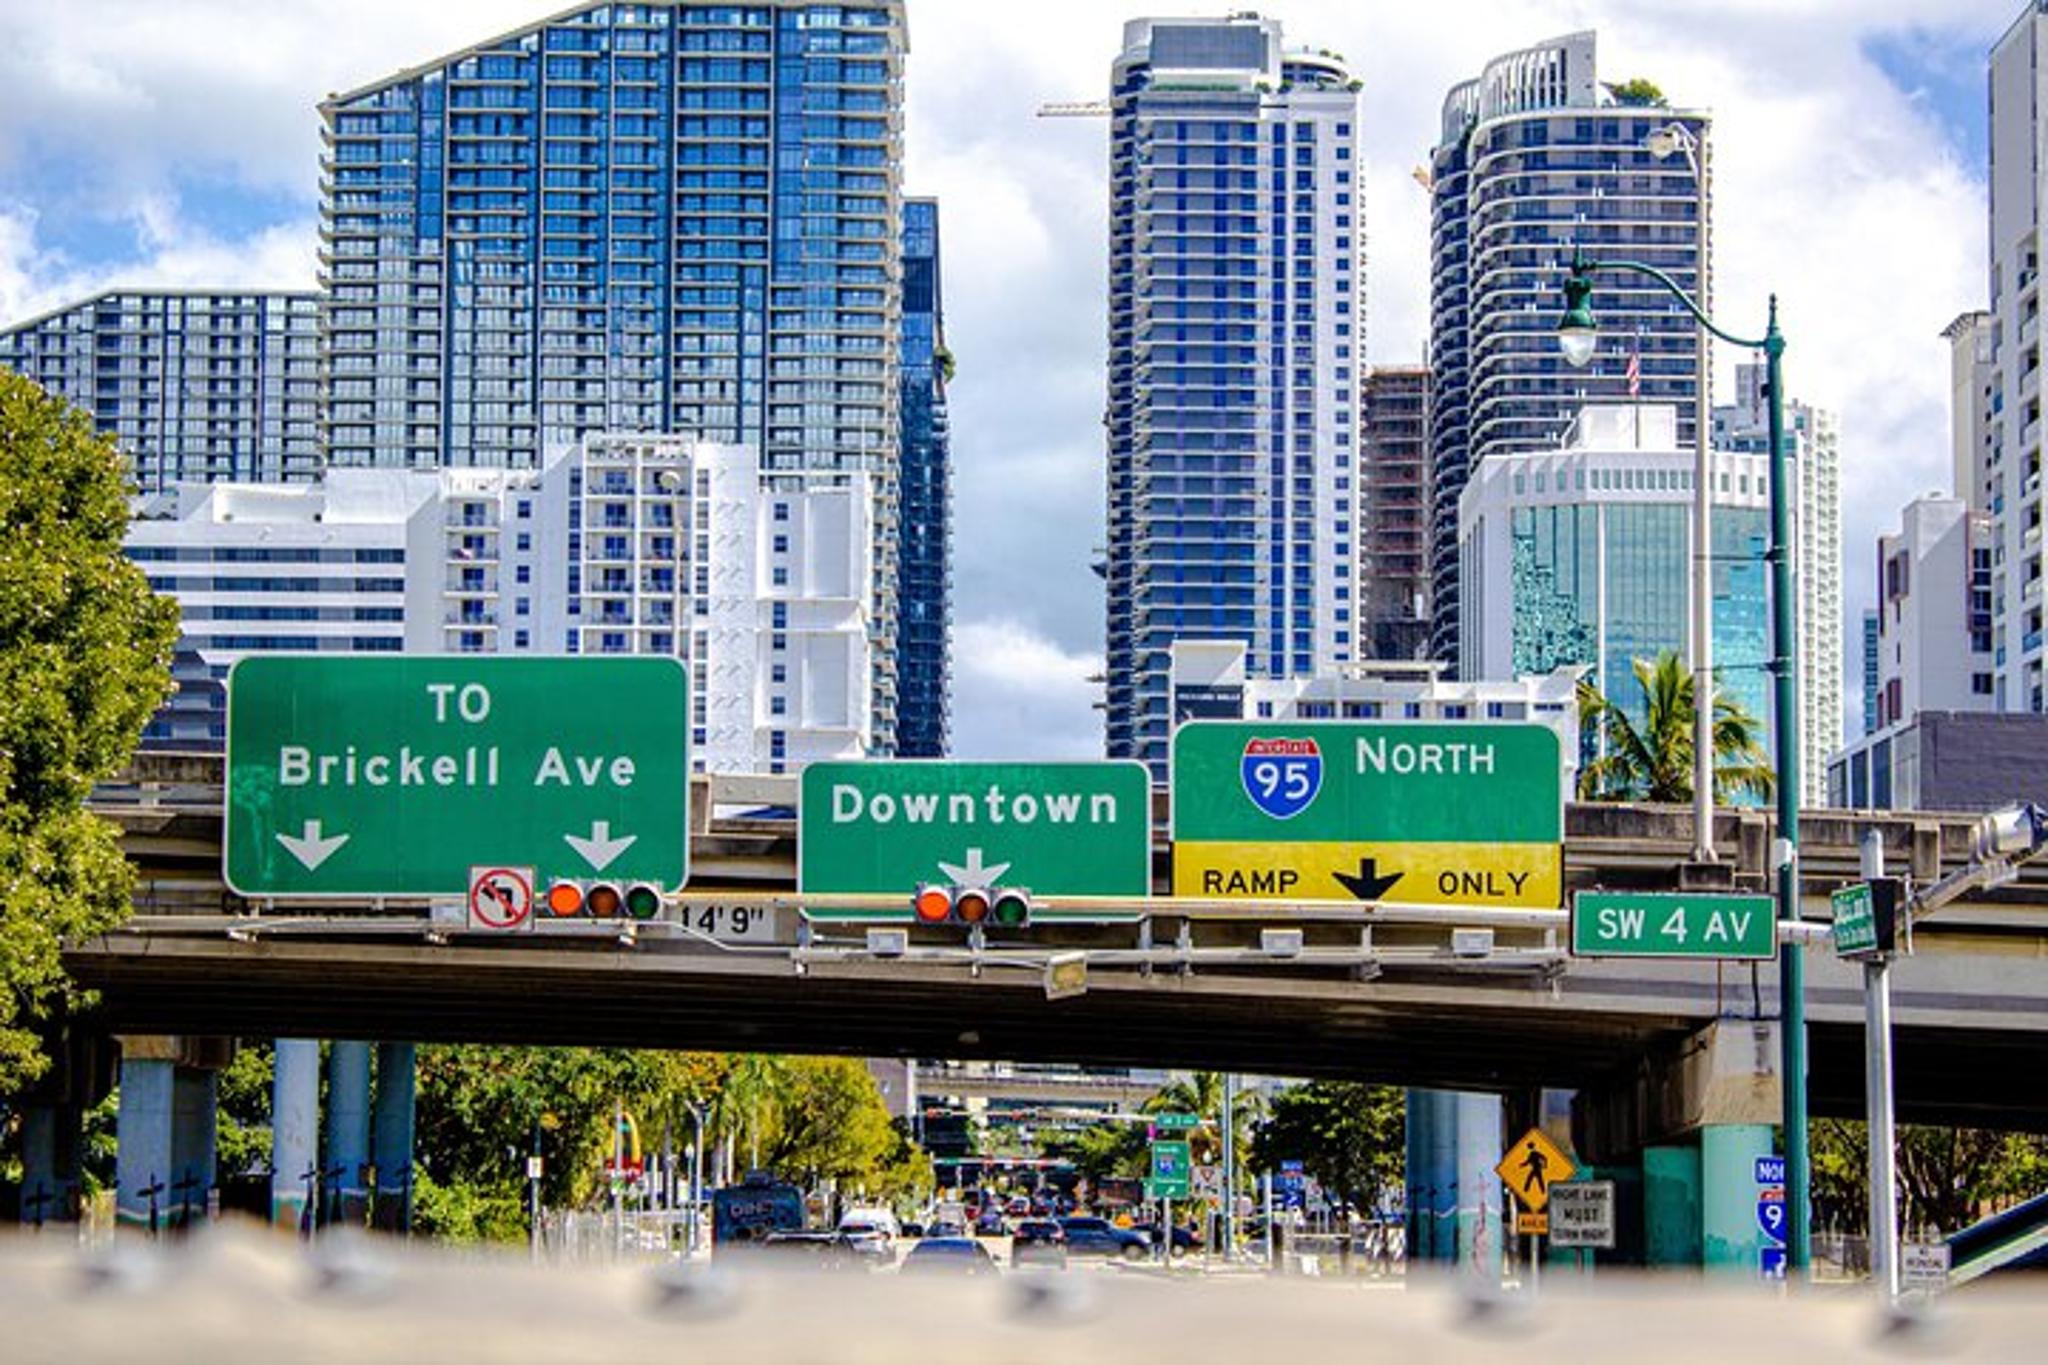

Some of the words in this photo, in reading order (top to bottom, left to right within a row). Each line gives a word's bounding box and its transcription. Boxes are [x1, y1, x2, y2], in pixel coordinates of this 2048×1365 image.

[427, 684, 490, 722] TO
[280, 746, 498, 785] Brickell
[534, 747, 636, 785] Ave
[1255, 762, 1310, 799] 95
[832, 785, 1116, 823] Downtown
[1203, 870, 1299, 894] RAMP
[1438, 871, 1529, 896] ONLY
[1598, 908, 1645, 940] SW
[1660, 907, 1688, 944] 4
[1703, 910, 1752, 942] AV
